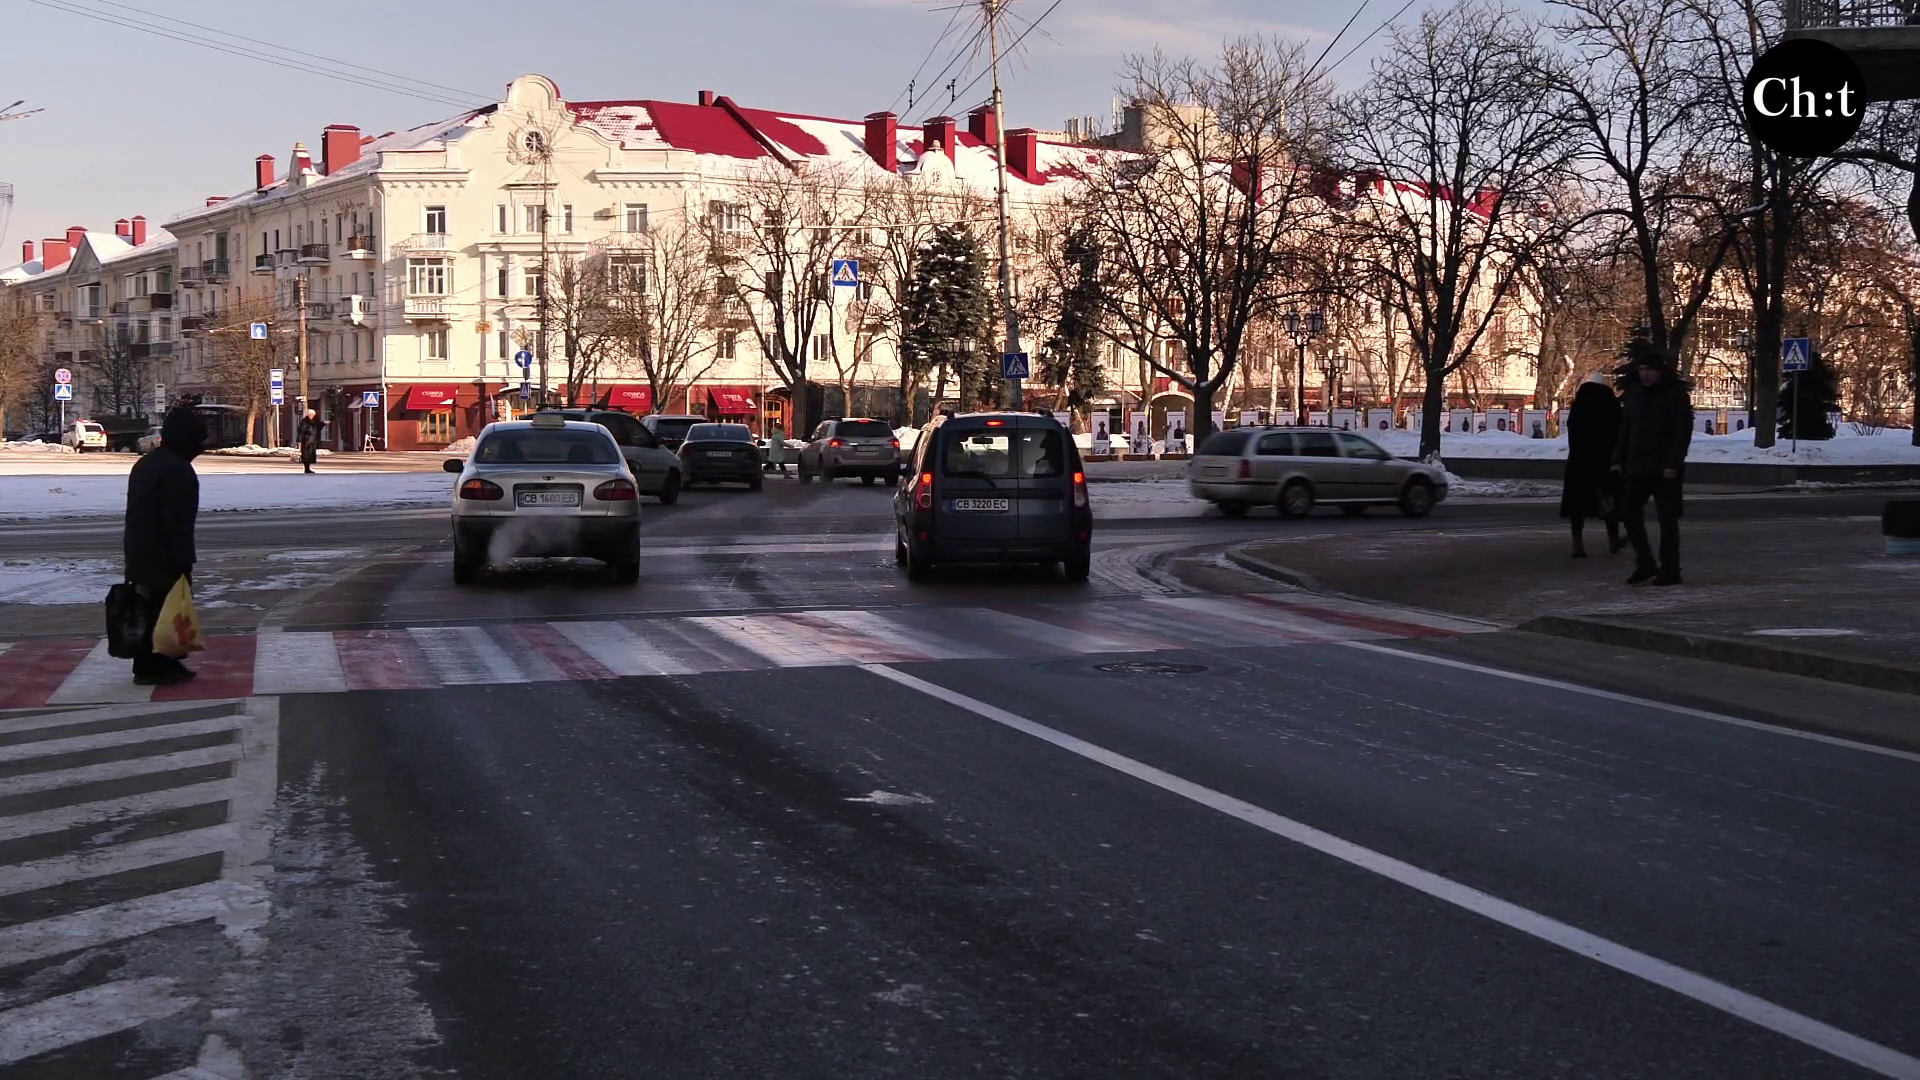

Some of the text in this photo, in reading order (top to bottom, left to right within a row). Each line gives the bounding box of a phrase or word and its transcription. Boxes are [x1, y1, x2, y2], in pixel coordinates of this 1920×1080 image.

[524, 494, 537, 503] CB
[562, 494, 576, 503] EB
[957, 500, 1006, 508] CB 3220 EC
